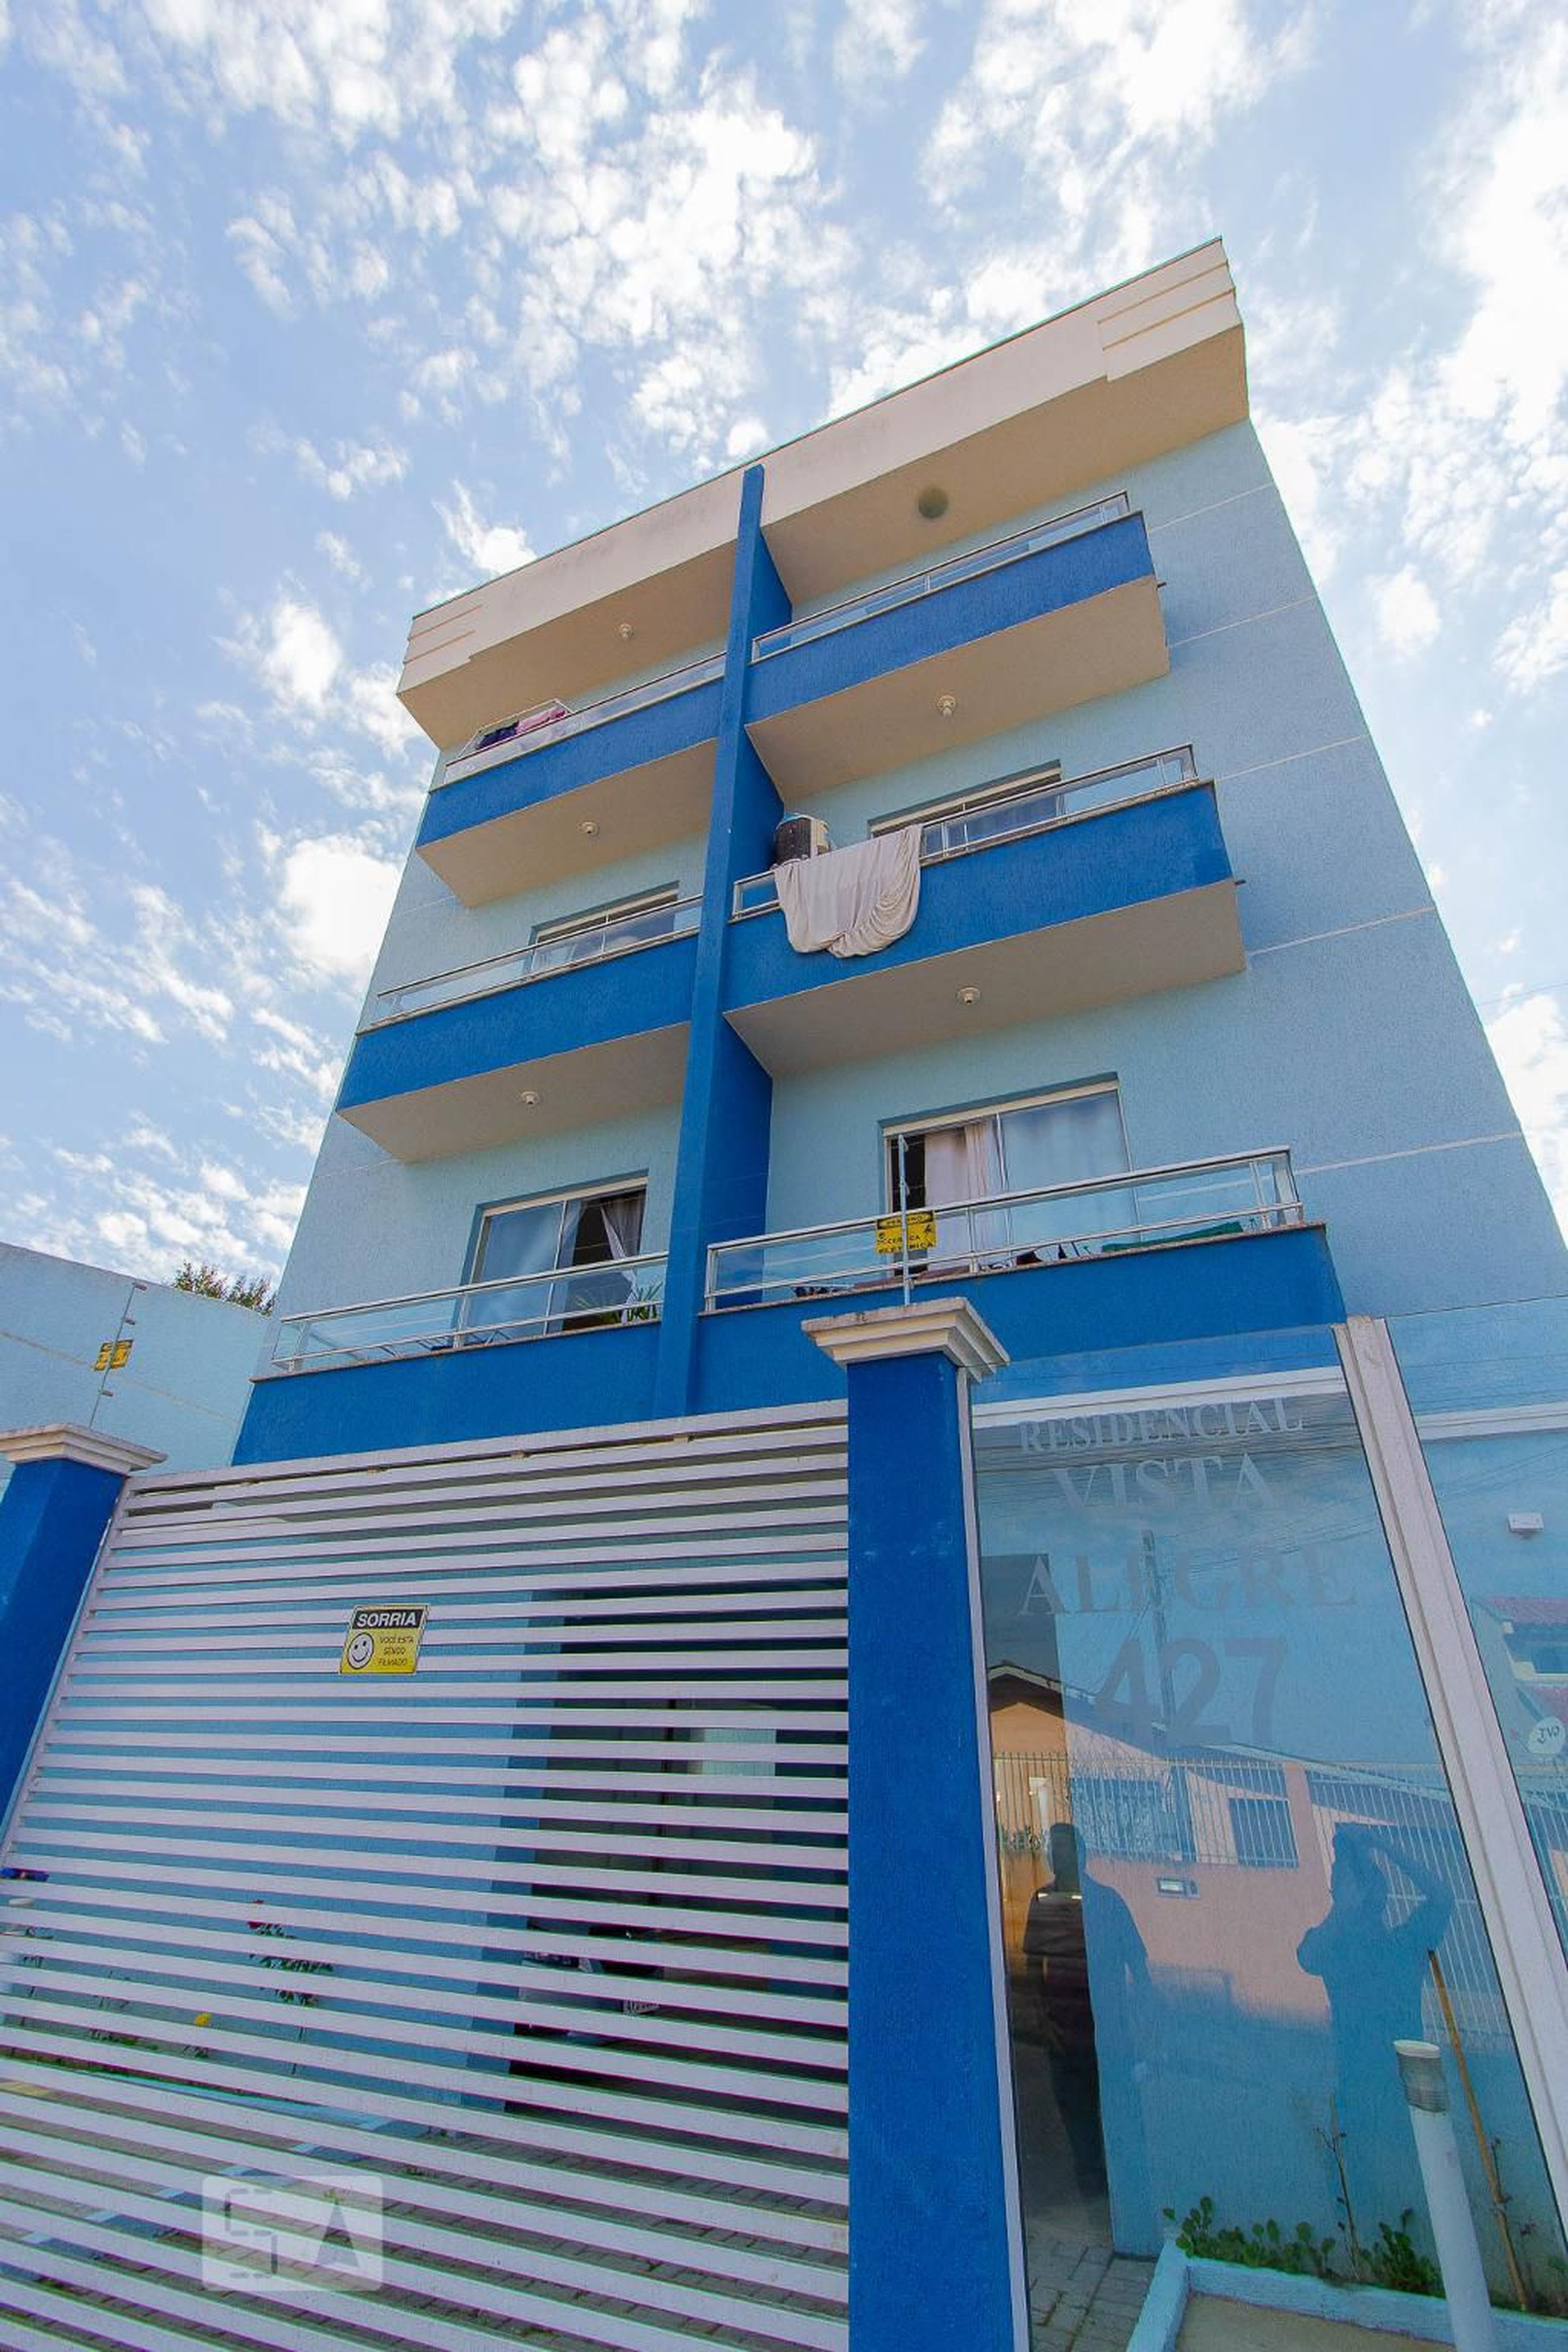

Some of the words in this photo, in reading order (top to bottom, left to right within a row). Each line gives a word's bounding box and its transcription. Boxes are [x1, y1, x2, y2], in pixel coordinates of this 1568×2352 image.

[1021, 1397, 1303, 1453] RESIDENCIAL
[1054, 1452, 1280, 1508] VISTA
[1016, 1541, 1357, 1617] ALEGRE
[356, 1612, 416, 1627] SORRIA
[1096, 1637, 1285, 1746] 427
